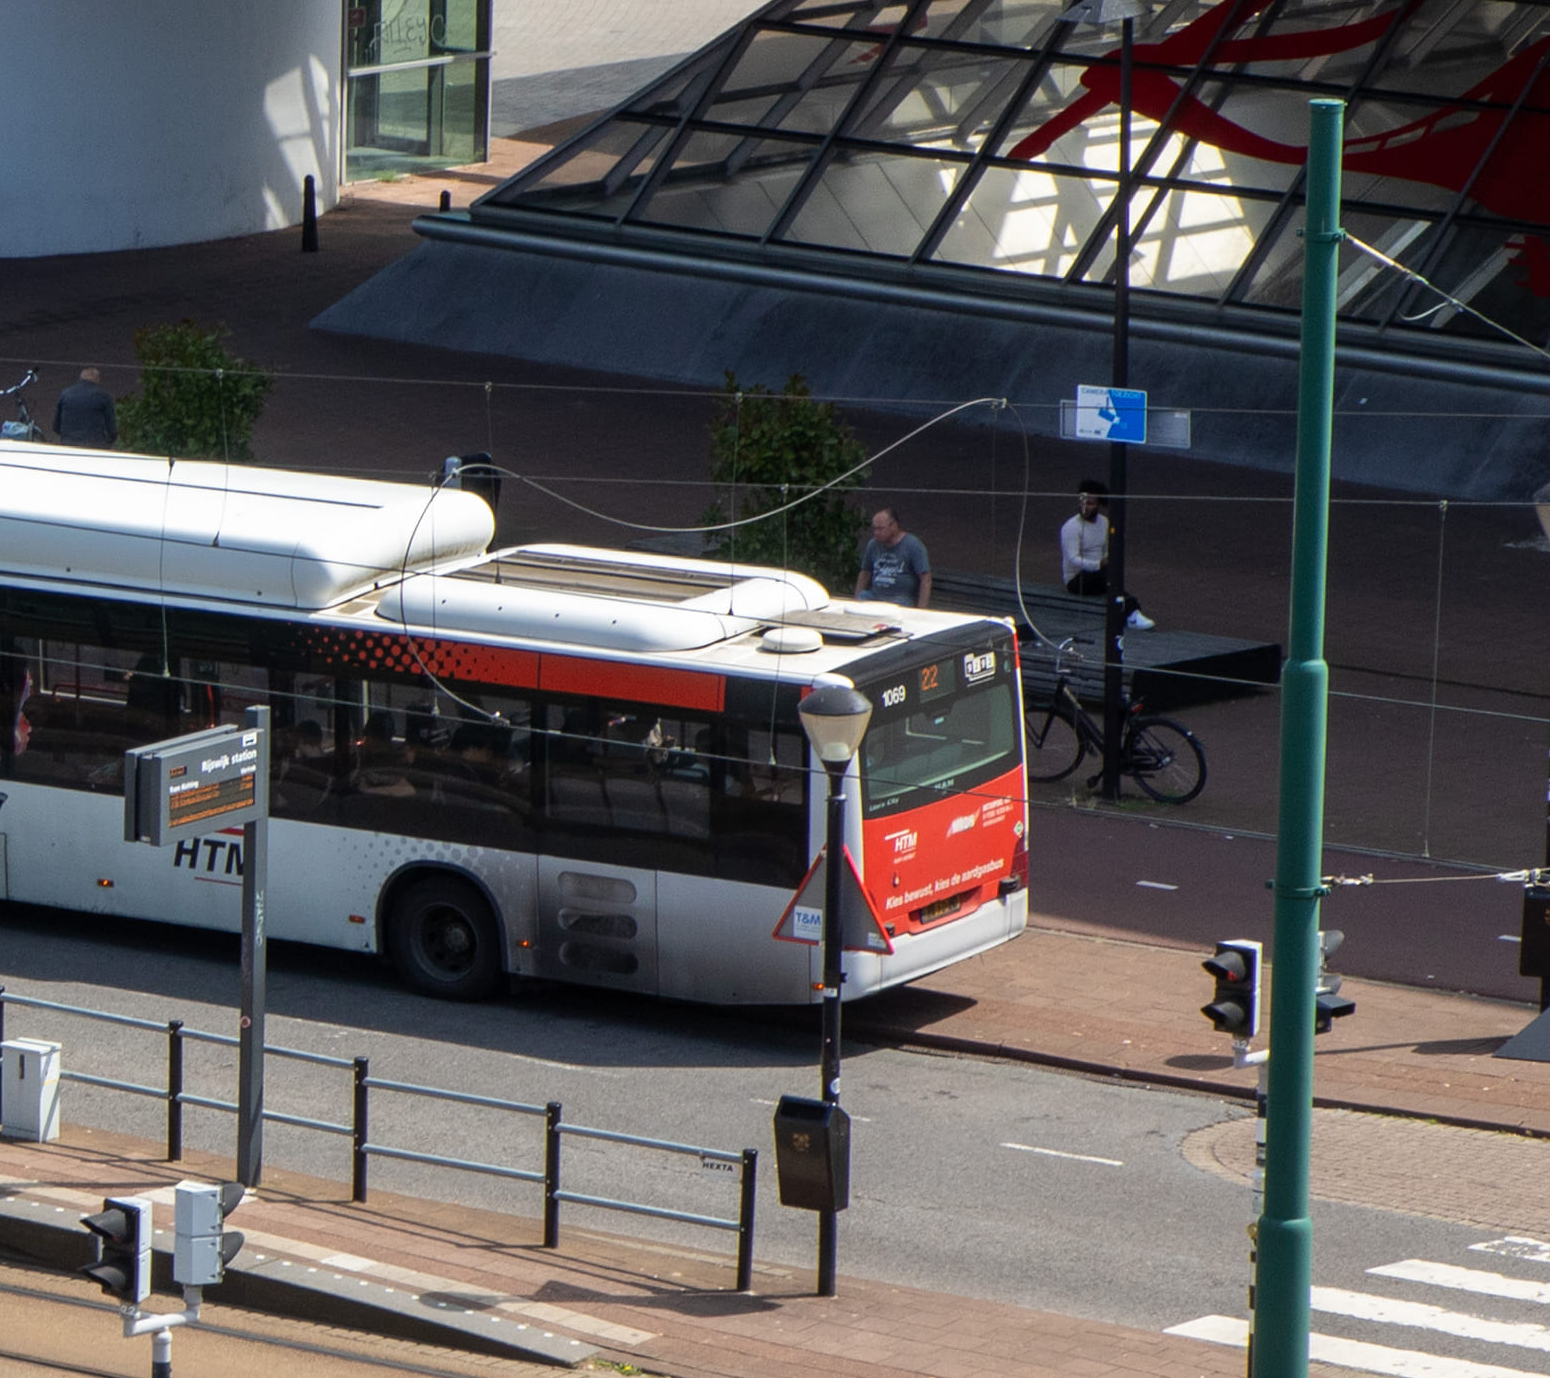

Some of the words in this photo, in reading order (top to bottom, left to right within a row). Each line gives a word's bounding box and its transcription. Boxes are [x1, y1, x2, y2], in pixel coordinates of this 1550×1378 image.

[921, 664, 939, 691] 22
[882, 685, 906, 707] 1069
[201, 754, 229, 773] Rijswijk
[231, 749, 257, 764] station
[895, 832, 918, 853] HTM
[885, 897, 904, 910] Kies
[934, 878, 949, 891] kies
[949, 875, 960, 887] de
[795, 911, 822, 925] T&M
[702, 1162, 733, 1172] HEXTA
